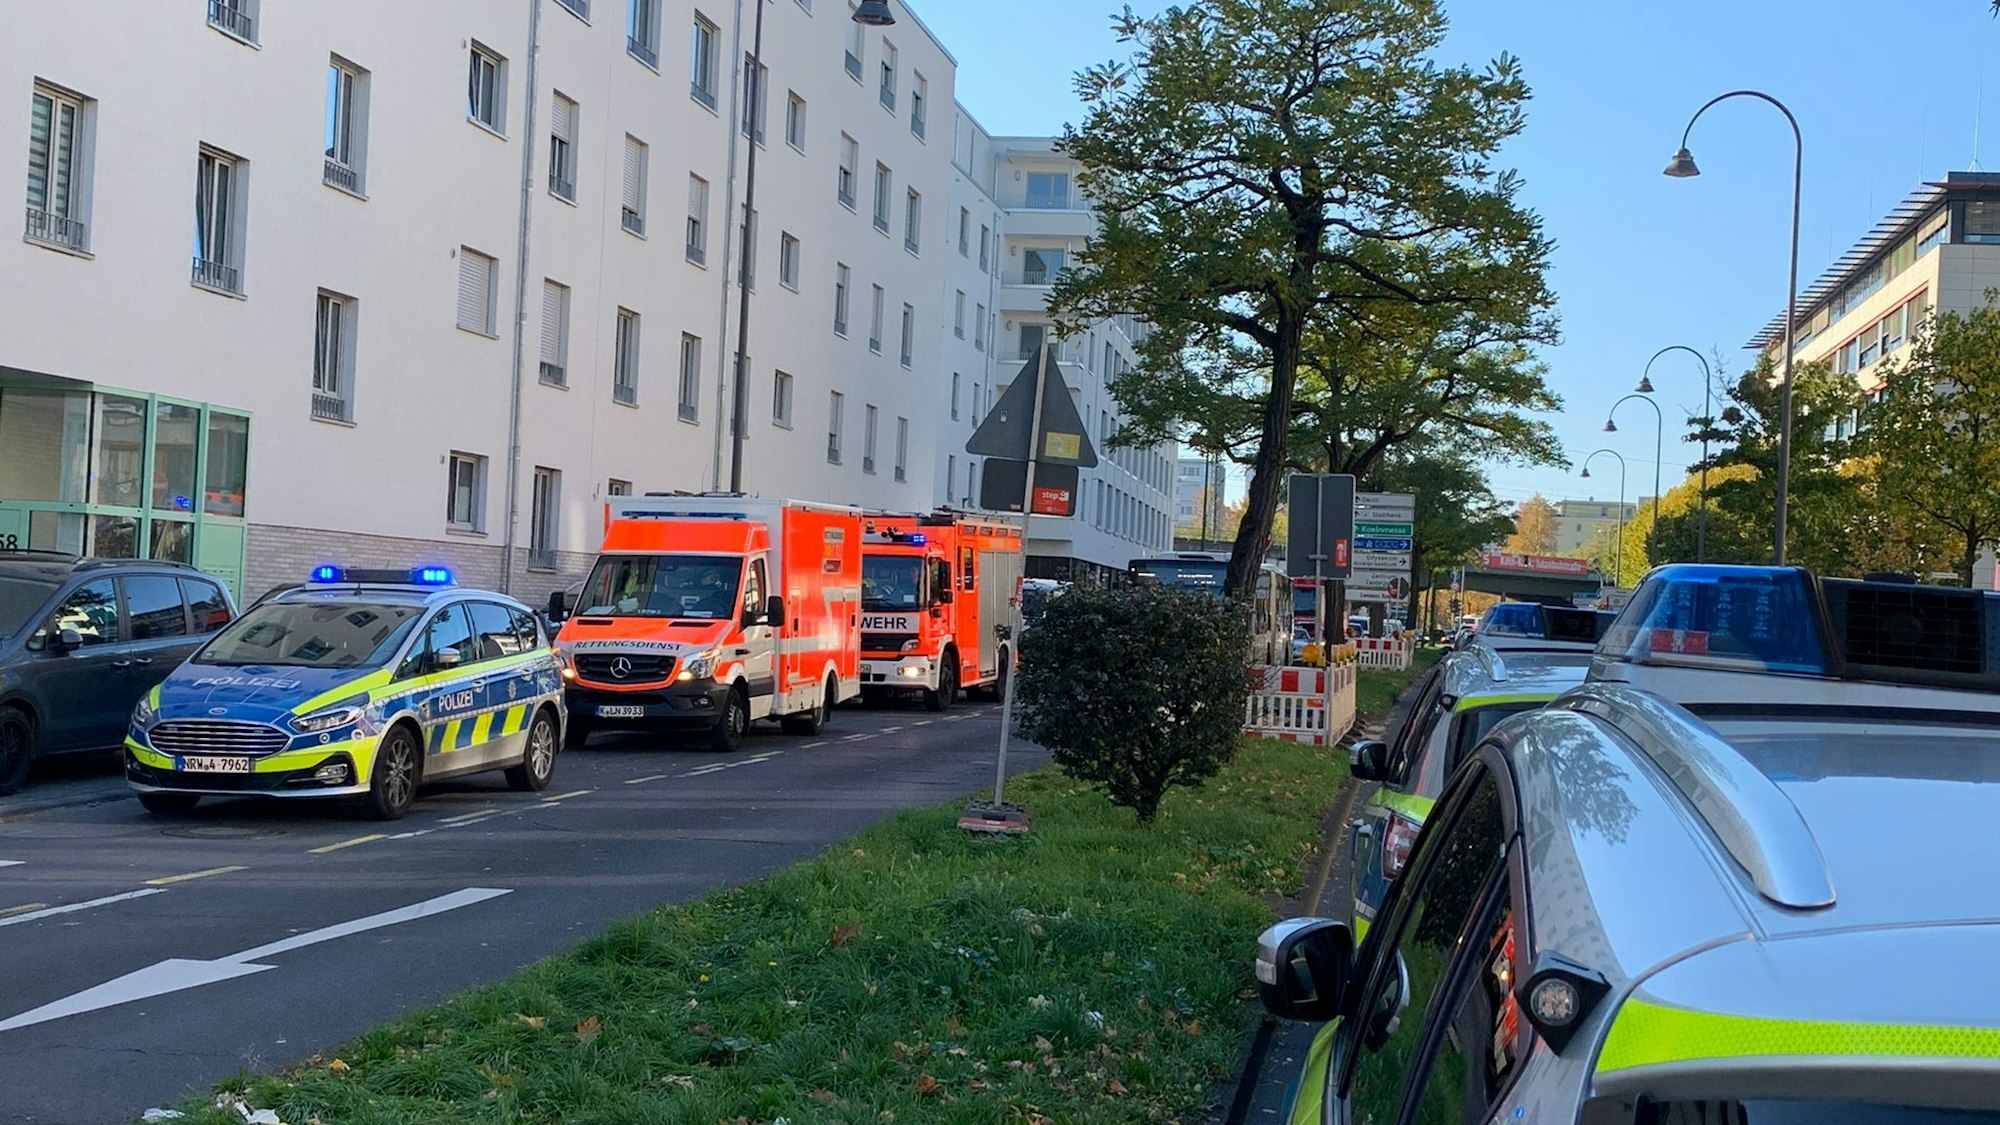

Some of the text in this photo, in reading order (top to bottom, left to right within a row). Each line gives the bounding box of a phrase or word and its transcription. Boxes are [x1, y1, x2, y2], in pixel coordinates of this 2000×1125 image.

[1361, 525, 1406, 534] Koelnmesse
[861, 617, 907, 630] WEHR
[574, 640, 682, 651] RETTUNGSDIENST
[192, 676, 301, 690] POLIZEI
[438, 689, 474, 712] POLIZEI
[623, 706, 643, 716] 3933
